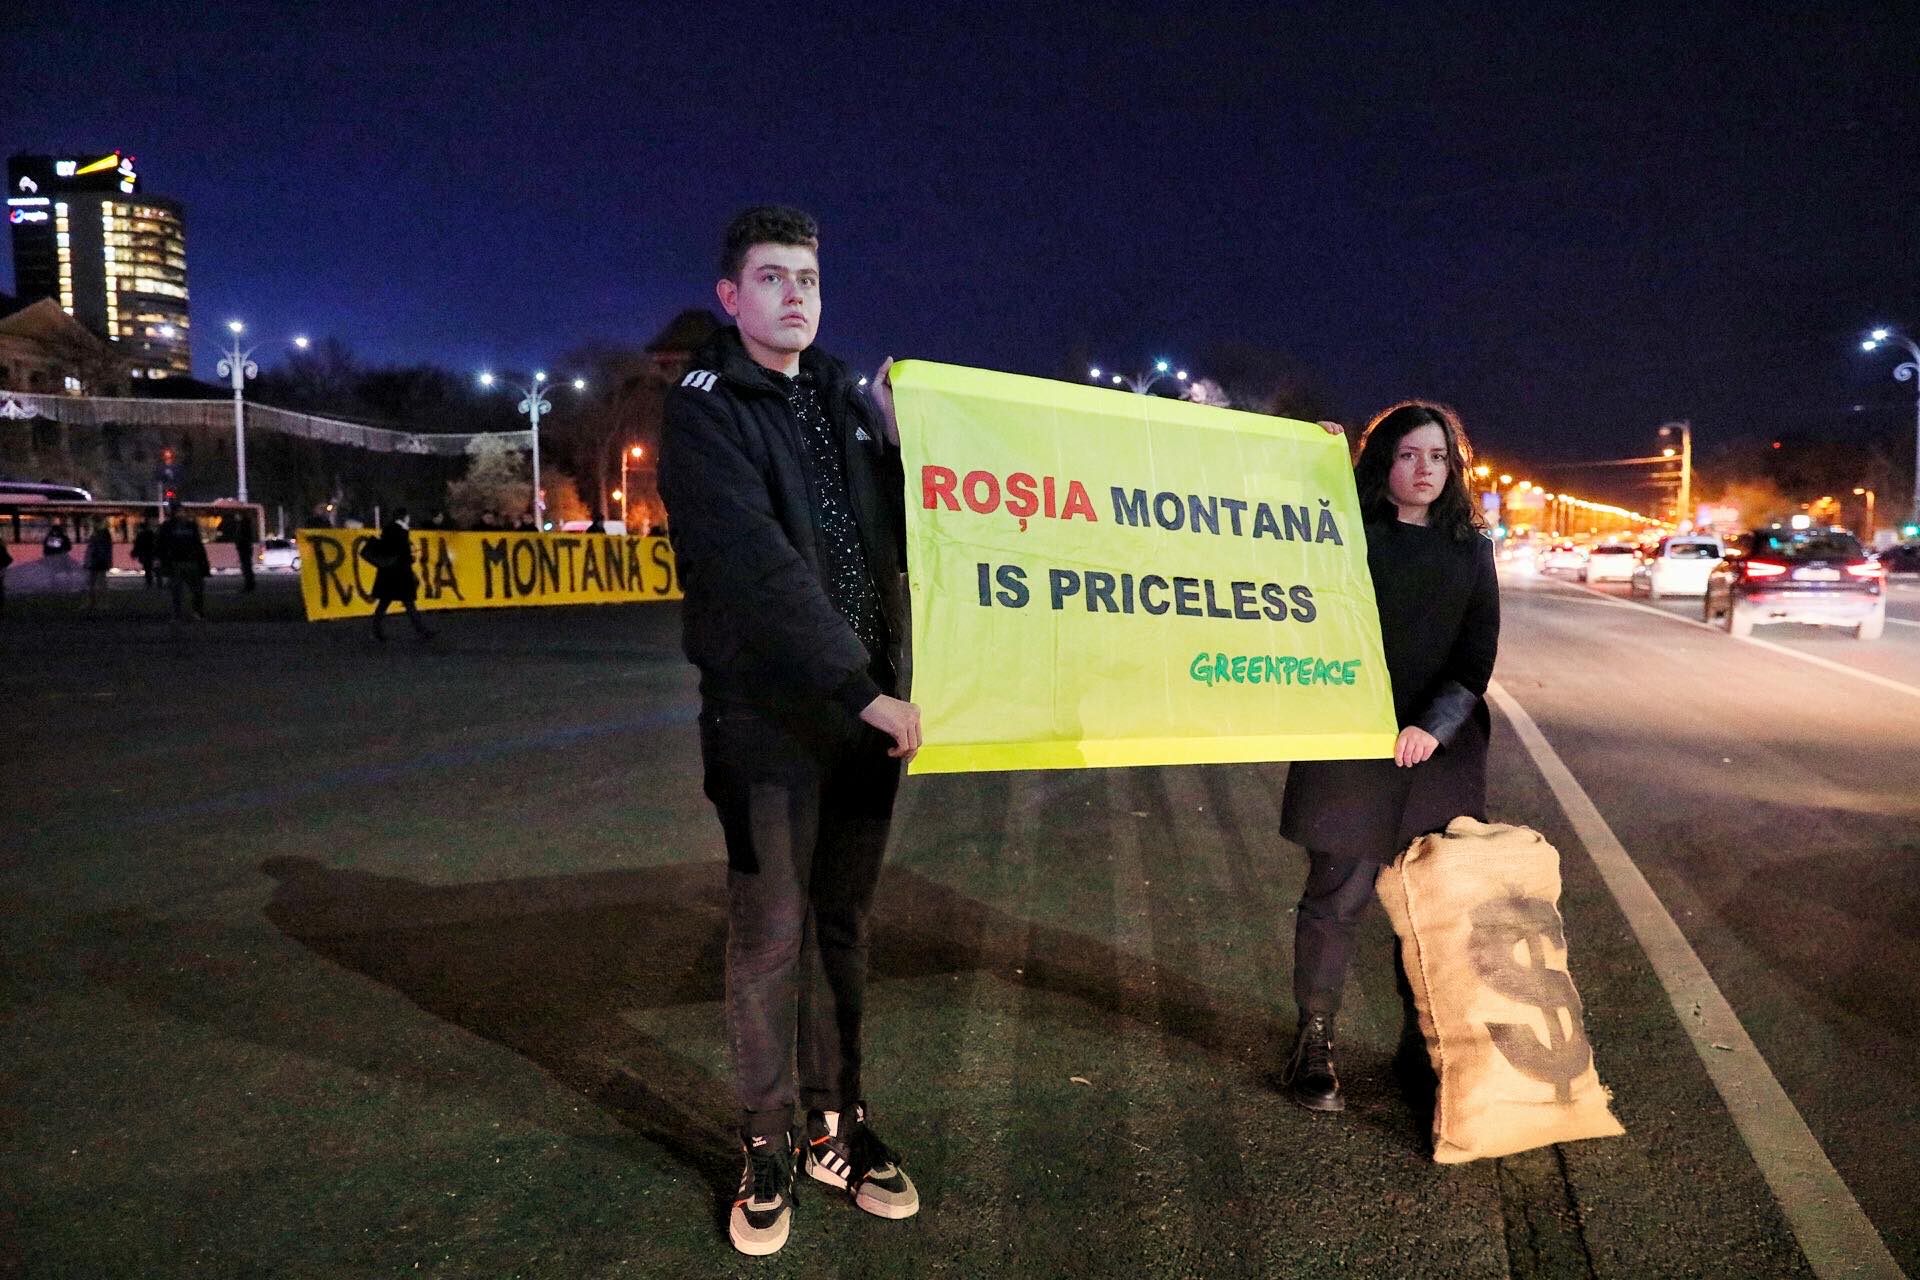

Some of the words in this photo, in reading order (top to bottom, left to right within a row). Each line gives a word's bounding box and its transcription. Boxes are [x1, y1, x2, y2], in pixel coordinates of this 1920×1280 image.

[921, 464, 1098, 532] ROȘIA
[1110, 486, 1345, 546] MONTANĂ
[976, 562, 1030, 609] IS
[1048, 568, 1318, 624] PRICELESS
[1189, 652, 1362, 688] GREENPEACE
